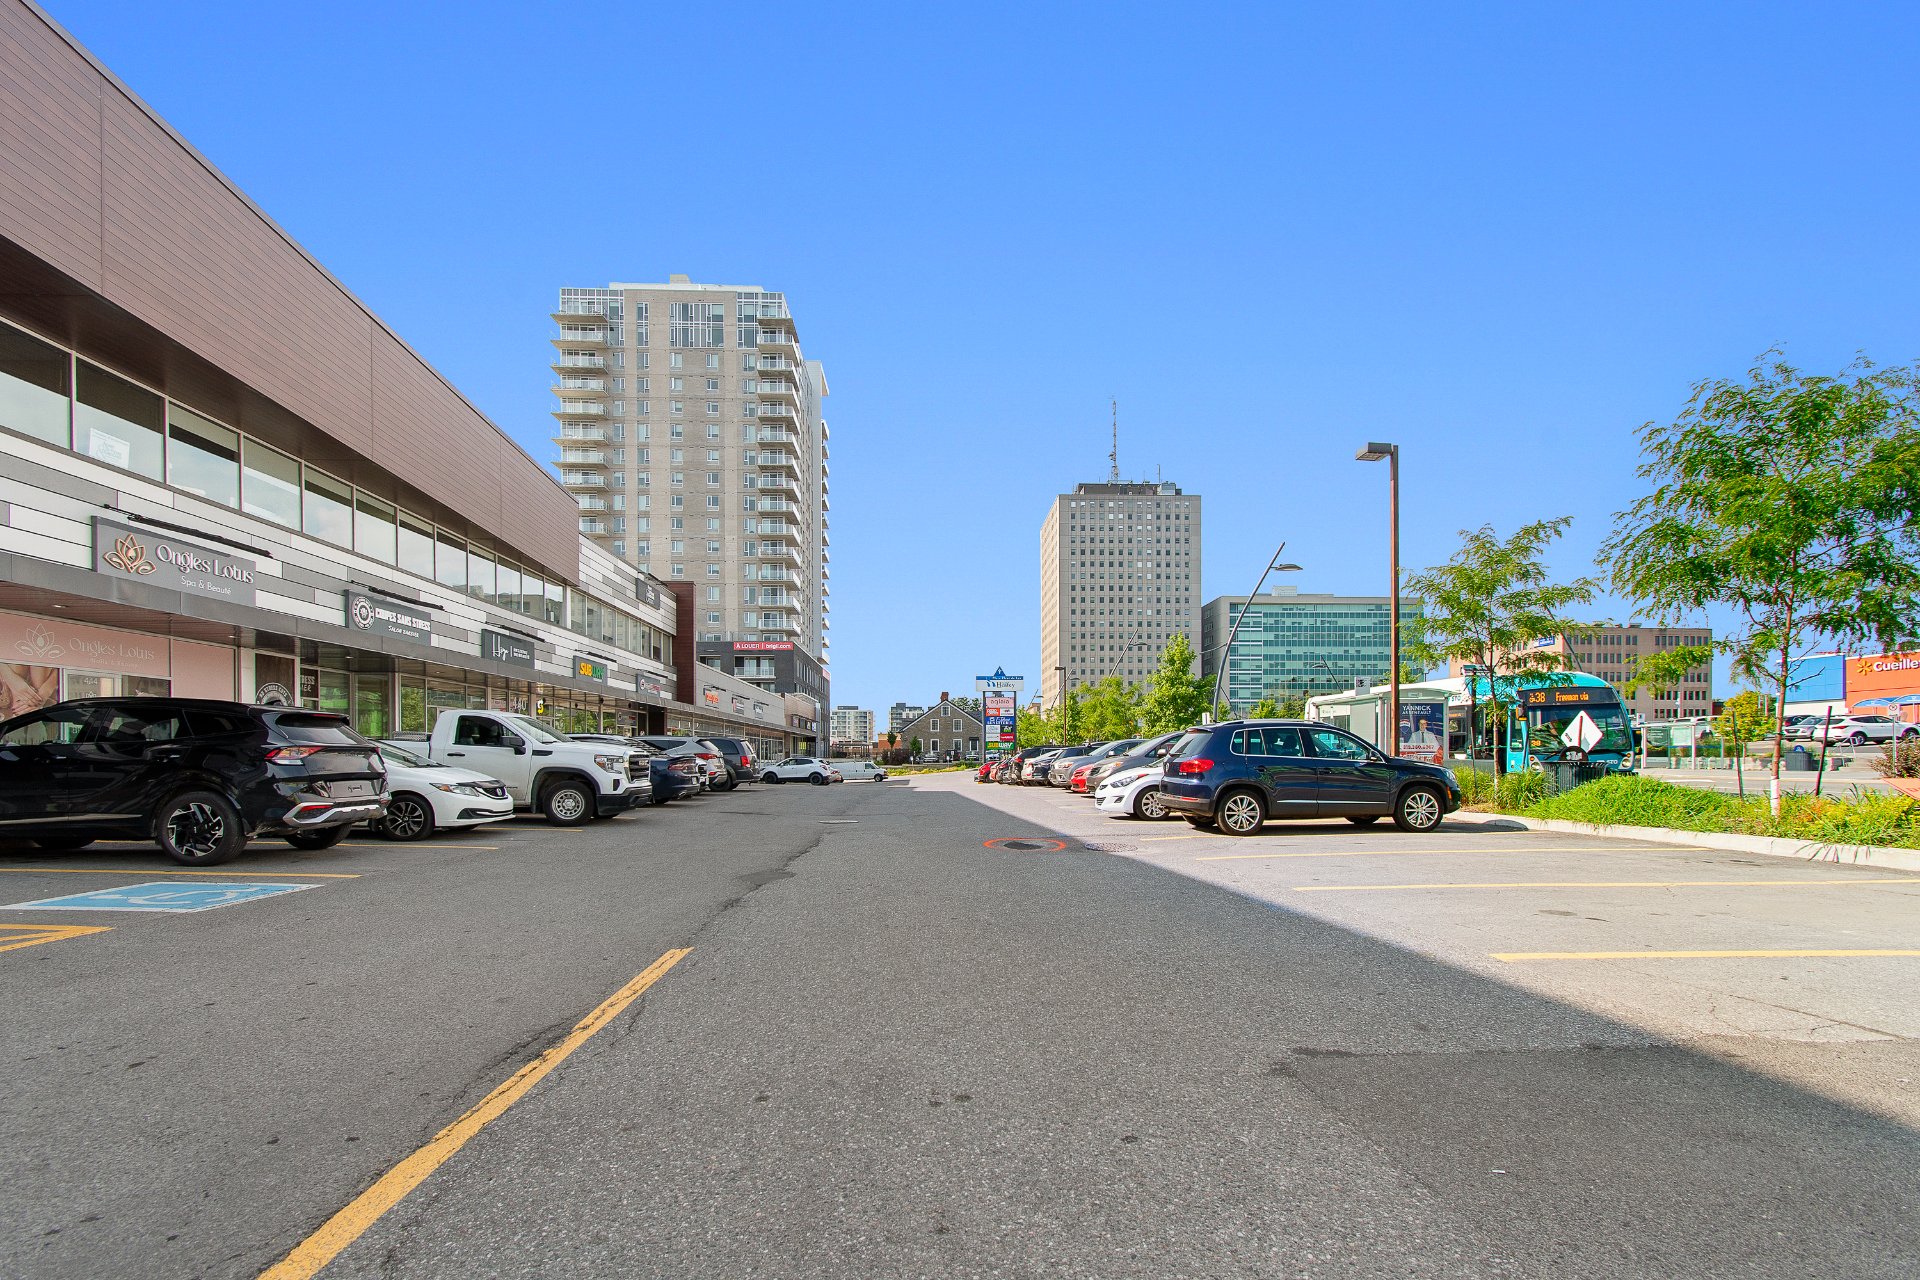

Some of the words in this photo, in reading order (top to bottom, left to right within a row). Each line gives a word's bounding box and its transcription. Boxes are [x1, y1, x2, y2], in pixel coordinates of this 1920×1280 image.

[156, 544, 211, 574] Ongles
[213, 559, 254, 584] Lotus
[181, 575, 197, 588] Spa
[198, 579, 205, 590] &
[207, 581, 232, 596] Beauté
[375, 607, 397, 623] COUPES
[396, 613, 412, 627] SANS
[411, 617, 431, 632] STRESS
[69, 637, 116, 658] Ongles
[119, 643, 155, 660] Lotus
[579, 662, 604, 679] SUBWAY
[1402, 704, 1432, 712] YANNICK
